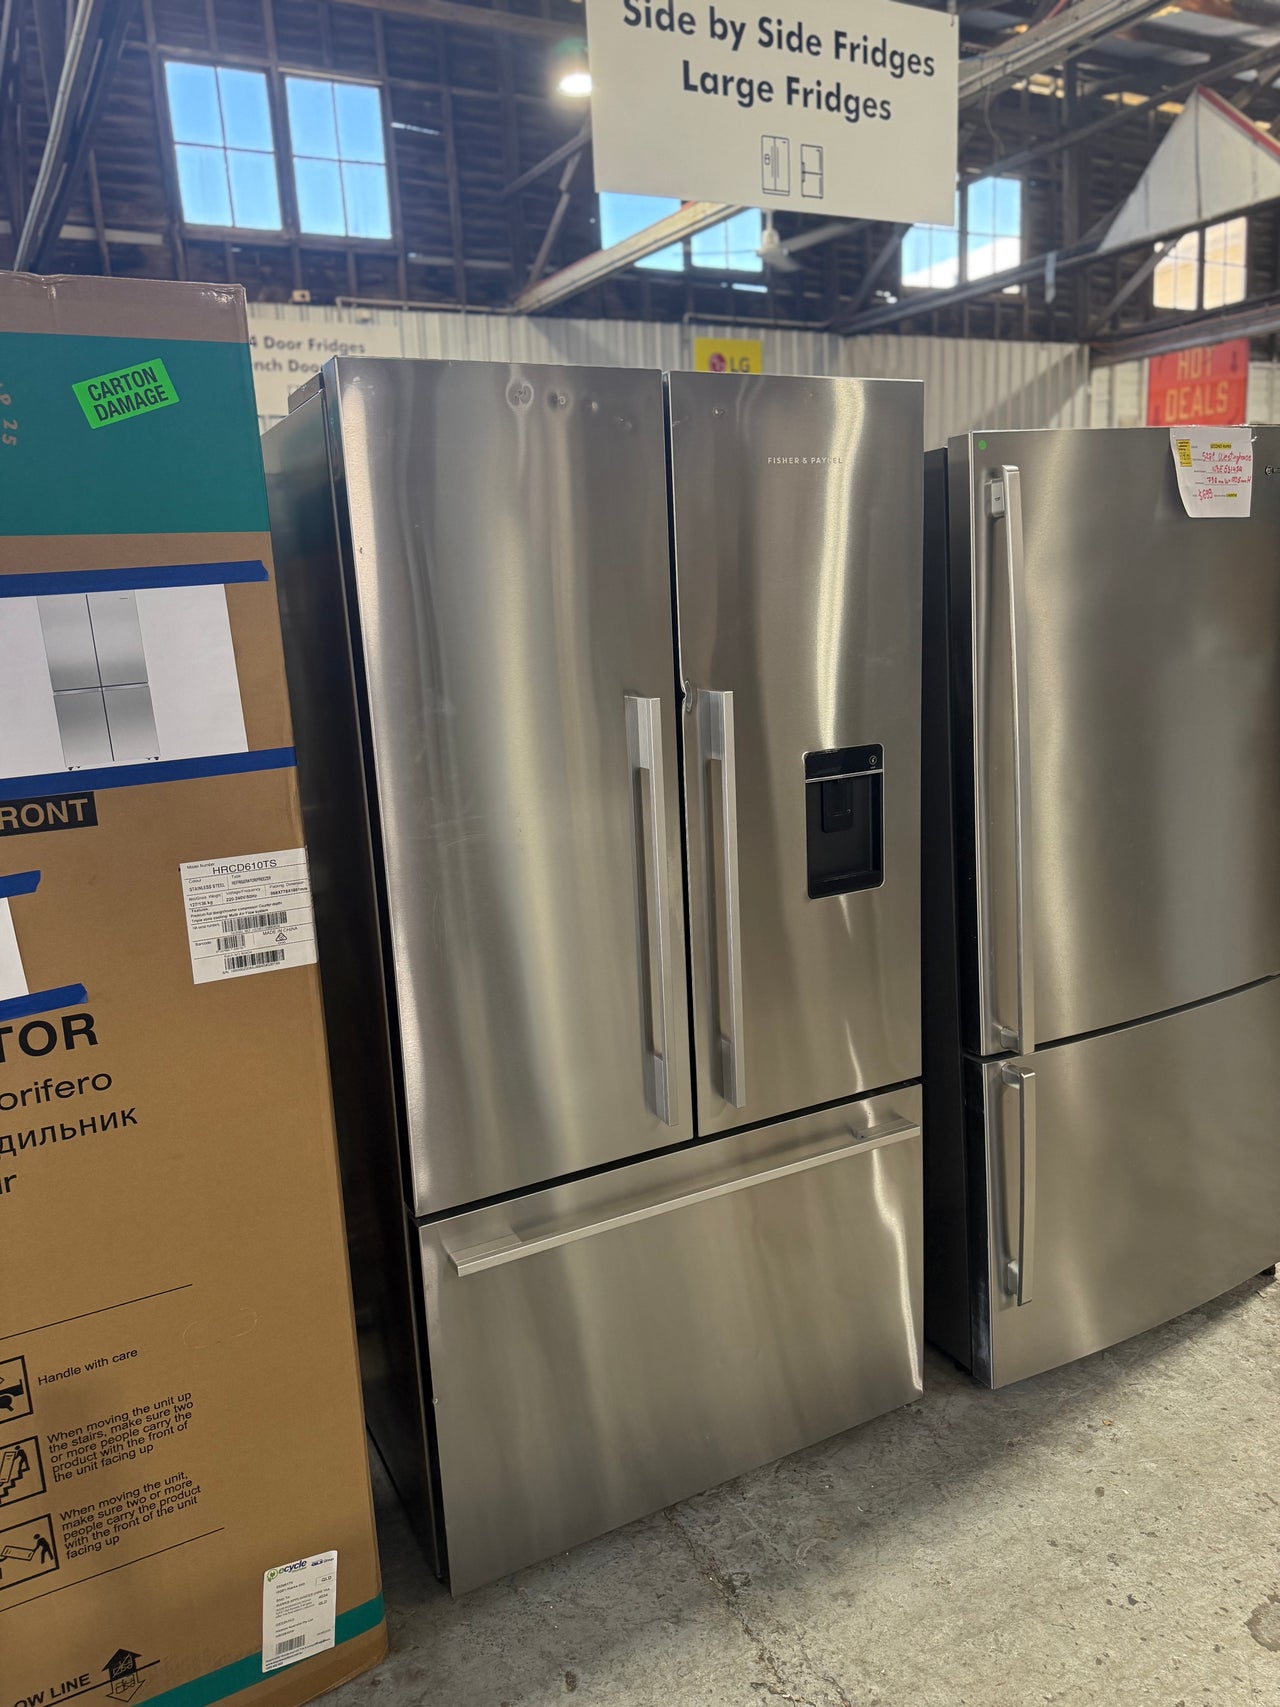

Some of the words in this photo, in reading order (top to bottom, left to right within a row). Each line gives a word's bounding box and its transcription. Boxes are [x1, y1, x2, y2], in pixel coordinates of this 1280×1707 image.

[623, 0, 696, 35] Side
[709, 5, 746, 51] by
[757, 16, 822, 57] Side
[833, 30, 935, 79] Fridges
[682, 59, 774, 109] Large
[785, 75, 892, 123] Fridges
[264, 336, 301, 350] Door
[308, 338, 365, 355] Fridges
[729, 356, 750, 373] LG
[1177, 346, 1216, 380] HOT
[88, 367, 158, 402] CARTON
[94, 385, 169, 421] DAMAGE
[1165, 381, 1229, 423] DEALS
[2, 419, 18, 447] 25
[212, 859, 277, 874] HRCD610TS
[0, 1073, 112, 1111] orifero
[37, 1367, 81, 1386] Handle
[84, 1358, 108, 1371] with
[112, 1349, 138, 1363] care
[47, 1427, 83, 1444] When
[86, 1412, 129, 1432] moving
[132, 1405, 150, 1417] the
[153, 1397, 174, 1410] unit
[177, 1392, 191, 1403] up
[49, 1440, 67, 1454] the
[72, 1431, 107, 1446] stairs,
[111, 1418, 142, 1434] make
[146, 1409, 170, 1422] sure
[174, 1402, 193, 1413] two
[51, 1454, 63, 1463] or
[66, 1443, 96, 1458] more
[101, 1428, 139, 1448] people
[143, 1418, 171, 1433] carry
[174, 1411, 192, 1423] the
[52, 1453, 97, 1474] product
[100, 1443, 123, 1456] with
[127, 1436, 145, 1448] the
[148, 1426, 174, 1441] front
[177, 1420, 188, 1431] of
[54, 1470, 72, 1483] the
[76, 1462, 98, 1476] unit
[101, 1450, 136, 1467] facing
[140, 1444, 154, 1454] up
[60, 1504, 95, 1521] When
[99, 1488, 140, 1509] moving
[143, 1481, 161, 1492] the
[164, 1471, 188, 1485] unit,
[62, 1513, 94, 1531] make
[98, 1505, 122, 1518] sure
[126, 1497, 146, 1509] two
[150, 1491, 161, 1500] or
[164, 1480, 192, 1495] more
[63, 1522, 103, 1542] people
[106, 1509, 135, 1525] carry
[138, 1502, 156, 1513] the
[160, 1485, 201, 1508] product
[64, 1536, 88, 1550] with
[92, 1527, 110, 1541] the
[114, 1518, 140, 1533] front
[143, 1511, 154, 1522] of
[156, 1504, 174, 1517] the
[177, 1496, 197, 1509] unit
[67, 1542, 102, 1560] facing
[105, 1535, 120, 1545] up
[279, 1560, 307, 1574] ecycle
[50, 1673, 91, 1698] LINE
